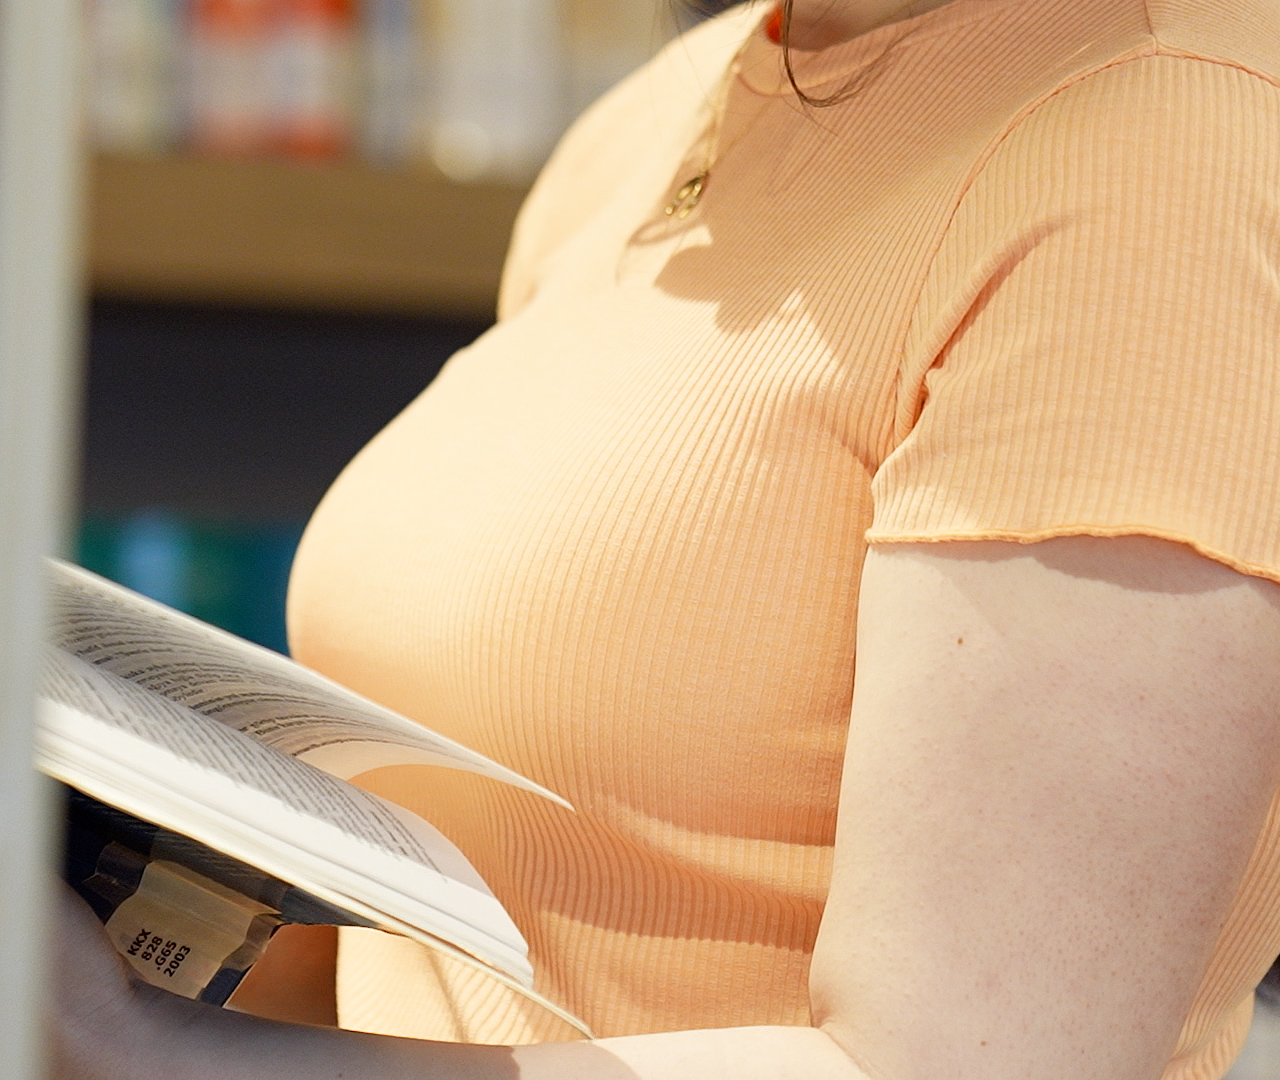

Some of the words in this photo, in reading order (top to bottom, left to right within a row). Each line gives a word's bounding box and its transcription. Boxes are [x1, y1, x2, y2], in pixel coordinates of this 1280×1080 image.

[127, 929, 151, 956] KKX
[141, 936, 163, 961] 828
[154, 941, 177, 971] .G65
[163, 945, 191, 977] 2003
